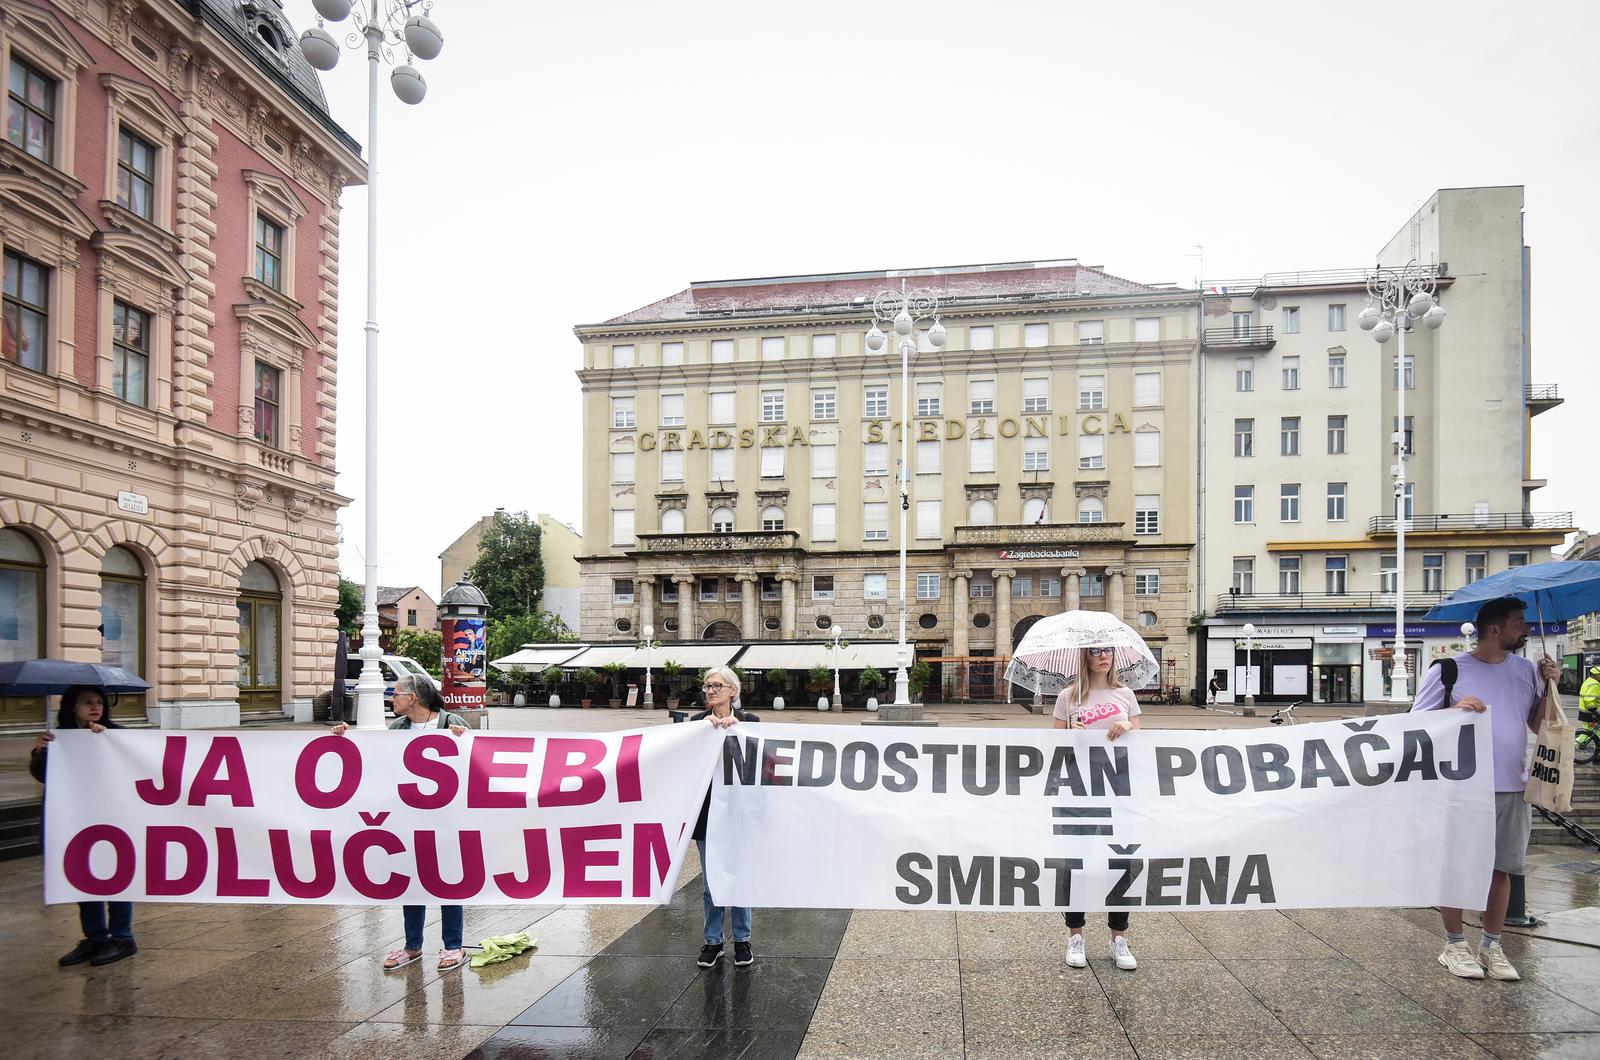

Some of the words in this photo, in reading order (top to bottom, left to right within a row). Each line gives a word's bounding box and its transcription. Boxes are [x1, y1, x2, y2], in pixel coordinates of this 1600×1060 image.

[637, 424, 808, 452] GRADSKA
[867, 412, 1131, 444] ŠTEDIONICA
[1008, 550, 1054, 560] Zagrebačka
[1055, 549, 1080, 558] banka
[443, 692, 482, 705] olutno
[135, 734, 255, 808] JA
[295, 734, 363, 810] O
[397, 733, 645, 810] SEBI
[722, 734, 1133, 798] NEDOSTUPAN
[1155, 719, 1477, 797] POBAČAJ
[895, 852, 1084, 907] SMRT
[1104, 843, 1277, 907] ŽENA
